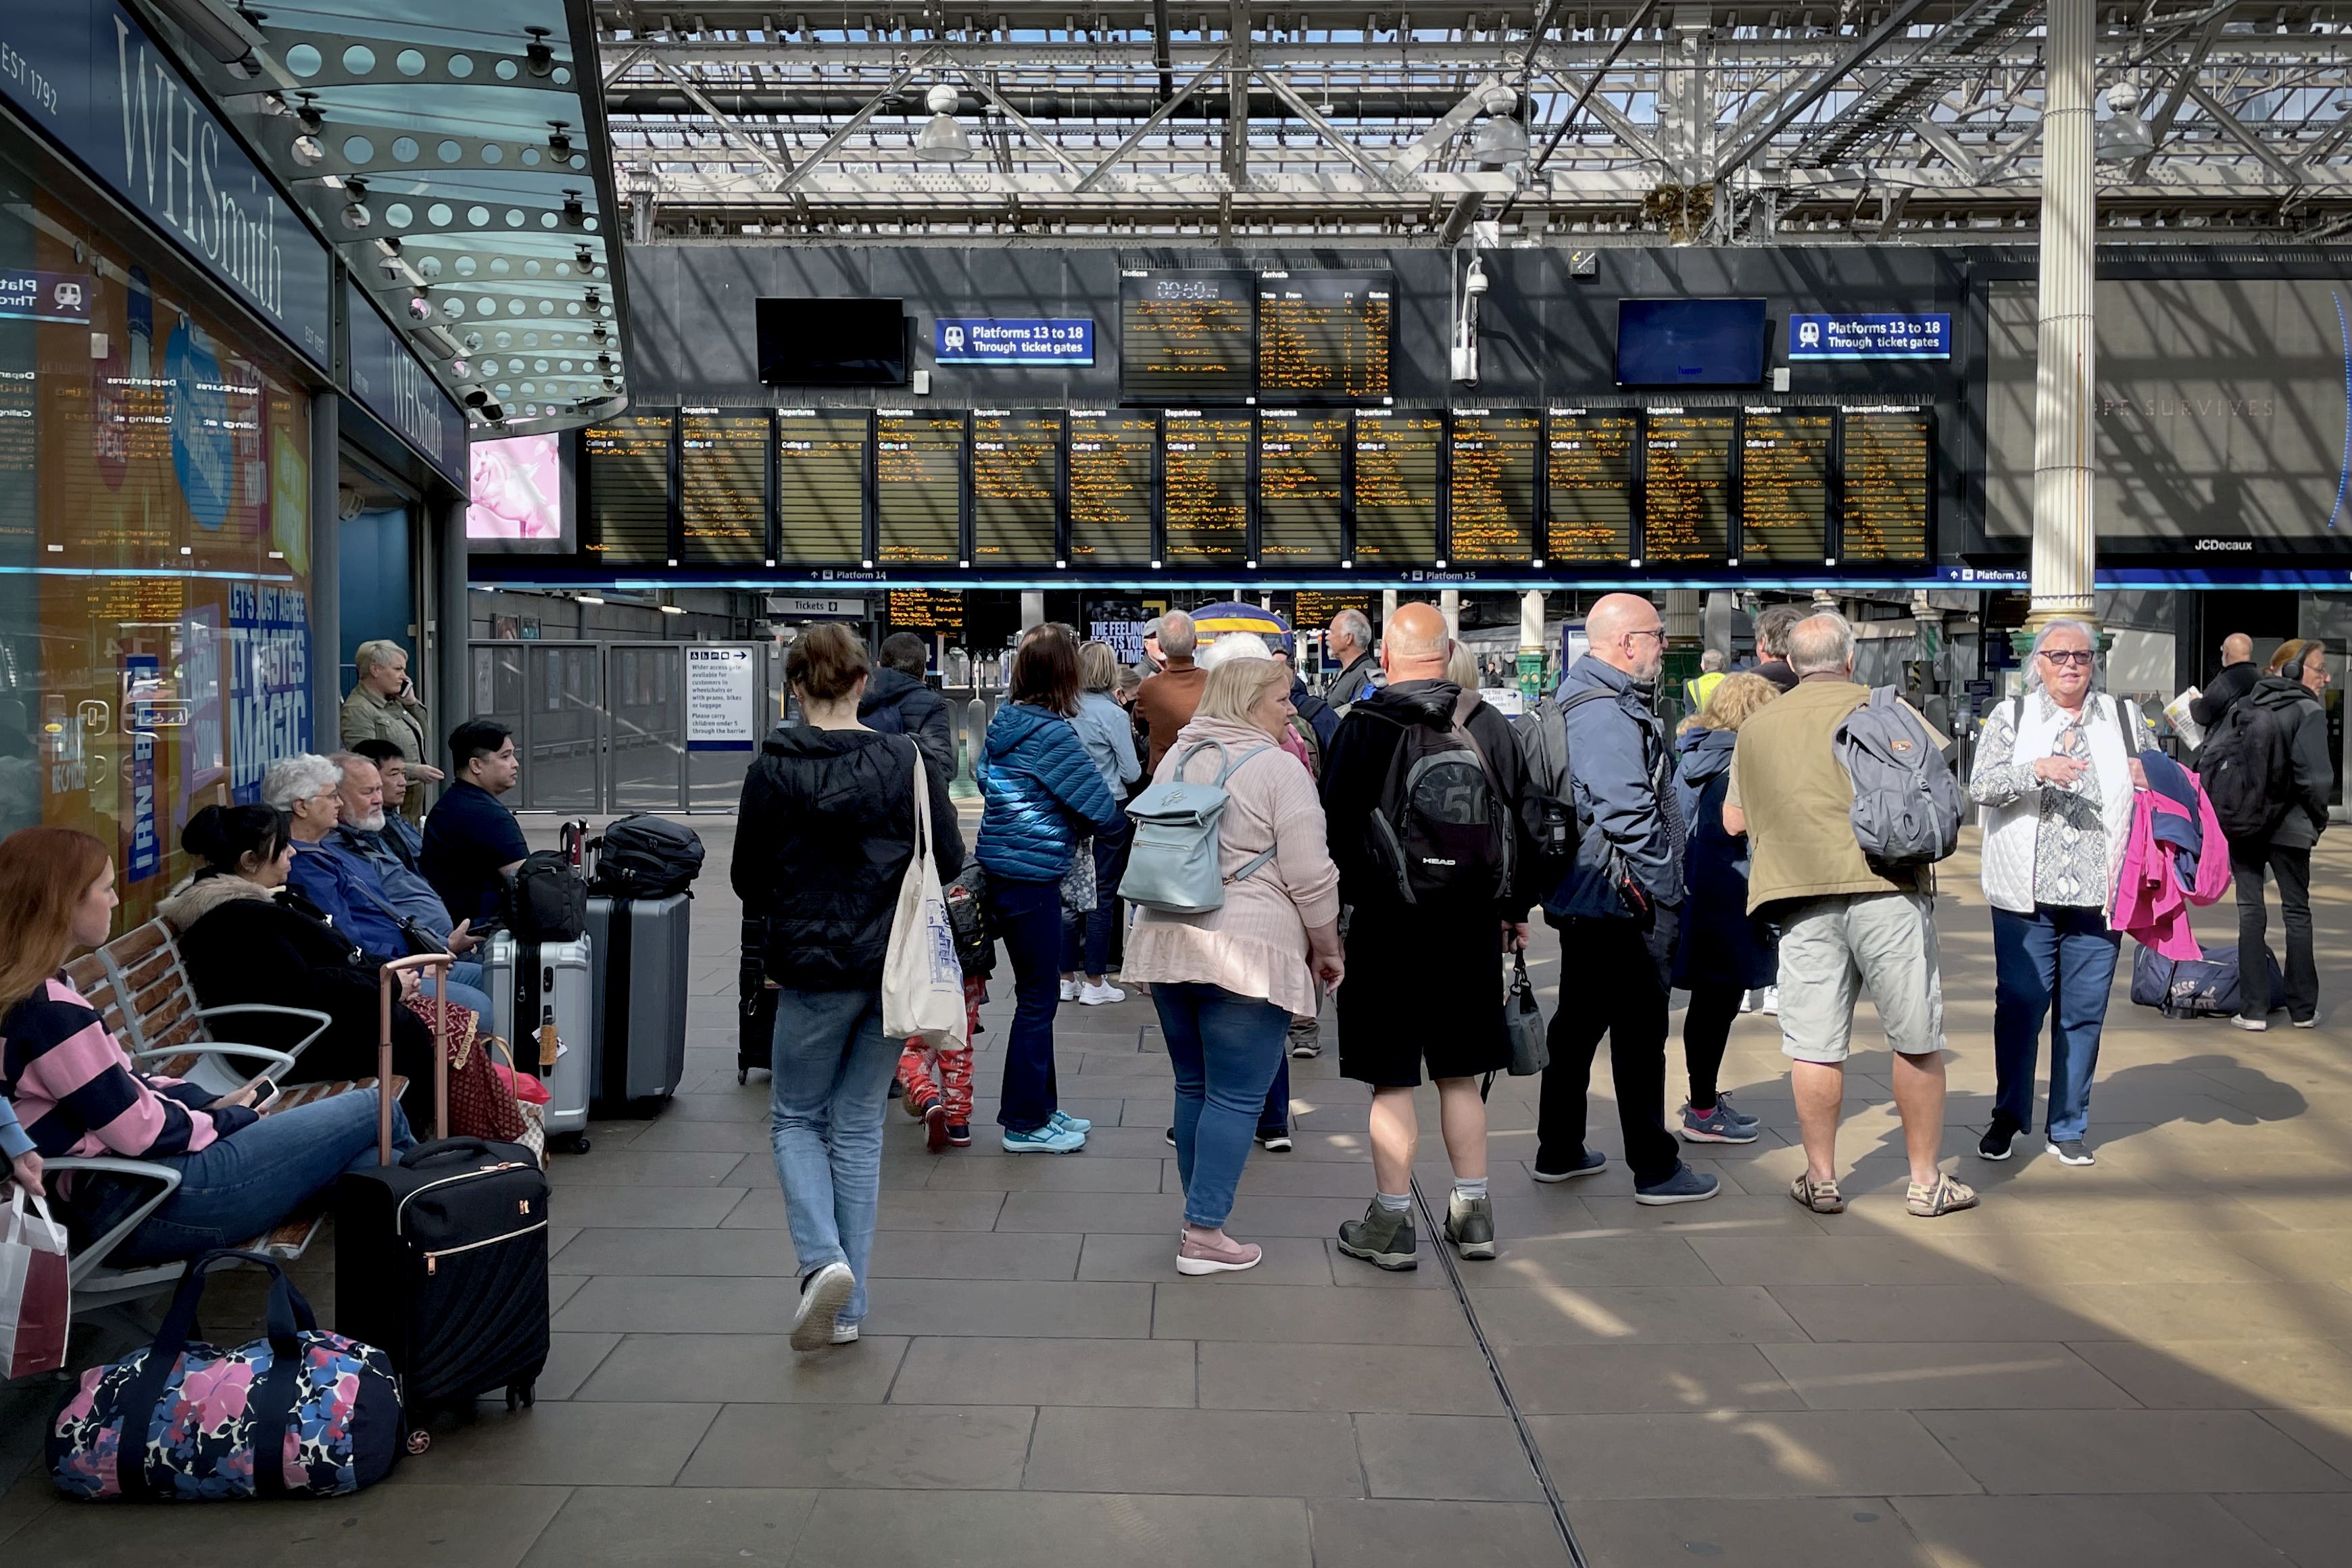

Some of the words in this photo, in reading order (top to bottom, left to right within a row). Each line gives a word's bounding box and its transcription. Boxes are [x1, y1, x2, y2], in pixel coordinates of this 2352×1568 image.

[1, 41, 26, 85] EST
[30, 70, 57, 116] 1792
[114, 13, 283, 320] WHSmith
[973, 326, 1030, 338] Platforms
[1033, 327, 1049, 338] 13
[1052, 327, 1064, 338] to
[1069, 327, 1083, 339] 18
[1828, 322, 1886, 334] Platforms
[1890, 322, 1905, 333] 13
[1908, 324, 1921, 333] to
[1925, 322, 1940, 333] 18
[973, 341, 1016, 354] Through
[1021, 341, 1052, 352] ticket
[1054, 343, 1083, 354] gates
[1828, 337, 1871, 349] Through
[1878, 337, 1907, 347] ticket
[1910, 338, 1940, 349] gates
[391, 339, 443, 463] WHSmith
[1647, 407, 1684, 415] Departures
[2145, 399, 2273, 416] SURVIVES
[1356, 409, 1392, 417] Departures
[586, 441, 606, 449] Calling
[684, 441, 703, 449] Calling
[781, 441, 801, 449] Calling
[879, 443, 899, 451] Calling
[976, 443, 996, 451] Calling
[1072, 443, 1091, 451] Calling
[1167, 443, 1187, 451] Calling
[1263, 443, 1282, 451] Calling
[1357, 443, 1377, 451] Calling
[1551, 441, 1571, 449] Calling
[1648, 441, 1669, 449] Calling
[1746, 440, 1766, 448] Calling
[2195, 539, 2252, 550] JCDecaux
[837, 571, 873, 579] Platform
[876, 571, 886, 579] 14
[1427, 572, 1463, 580] Platform
[1465, 572, 1476, 580] 15
[1977, 570, 2013, 580] Platform
[2016, 570, 2028, 580] 16
[228, 581, 255, 620] LET'S
[256, 586, 278, 621] JUST
[279, 589, 305, 622] AGREE
[795, 601, 824, 610] Tickets
[1090, 621, 1108, 635] THE
[1127, 636, 1144, 650] YOU
[230, 627, 248, 691] IT
[250, 628, 305, 689] TASTES
[230, 690, 306, 789] MAGIC
[1423, 857, 1456, 866] HEAD
